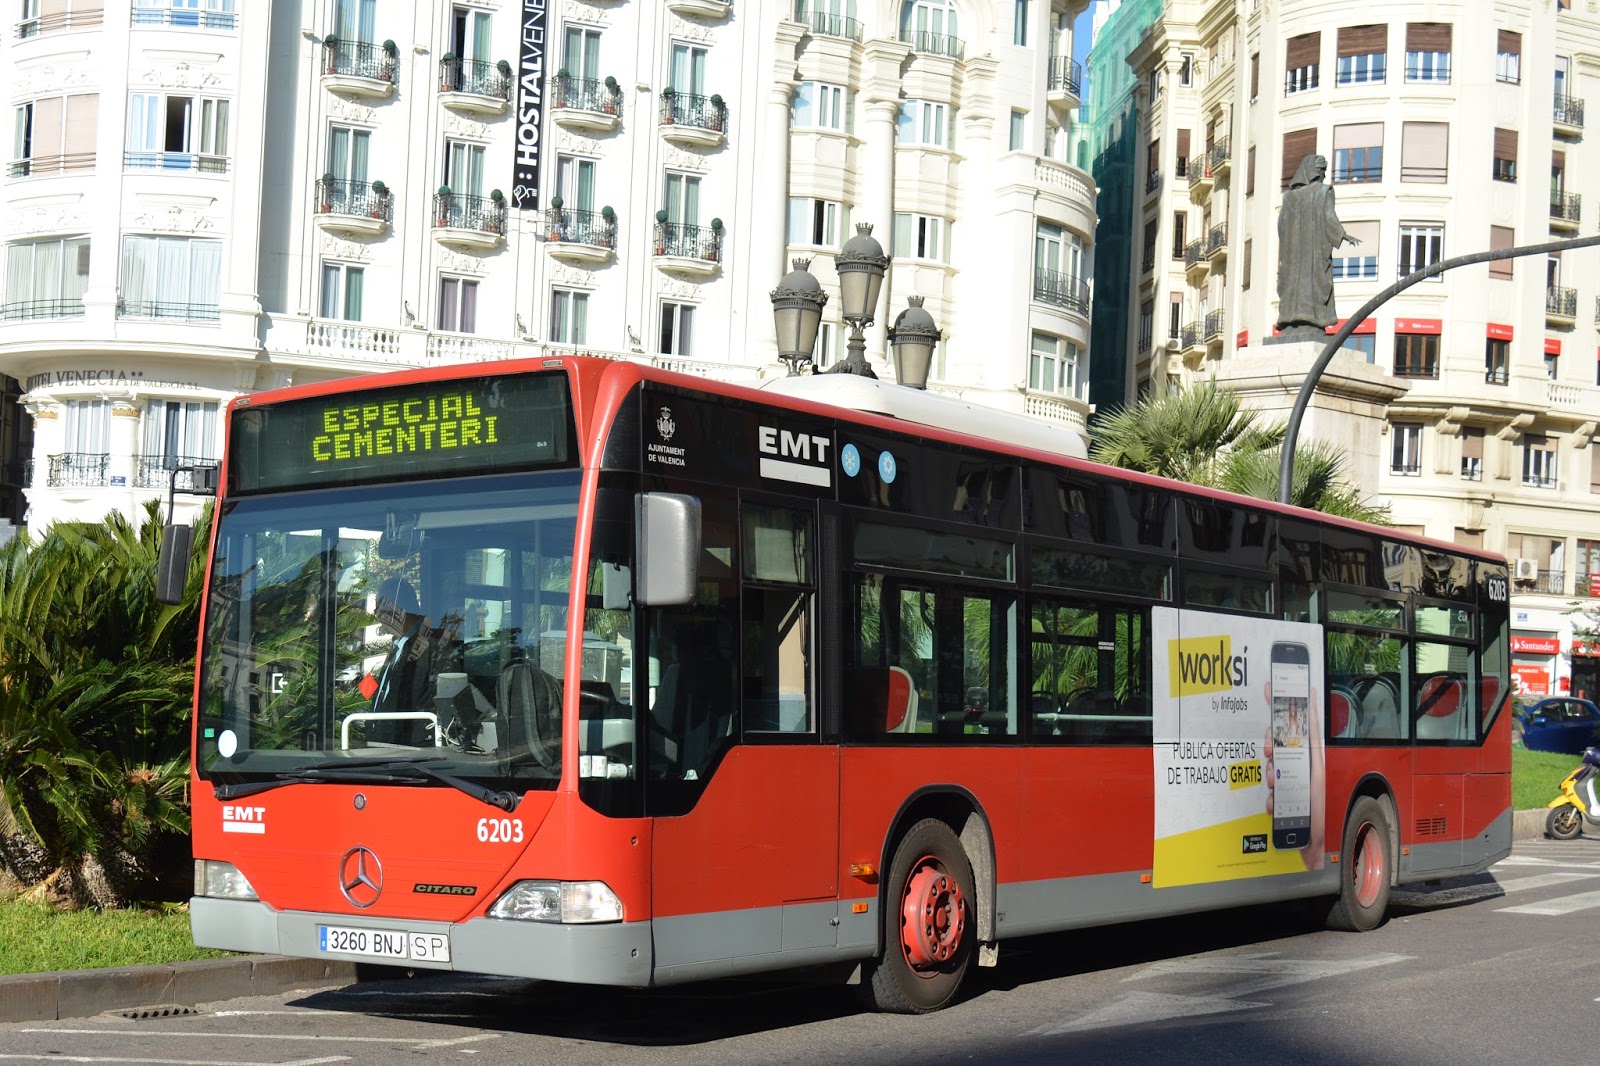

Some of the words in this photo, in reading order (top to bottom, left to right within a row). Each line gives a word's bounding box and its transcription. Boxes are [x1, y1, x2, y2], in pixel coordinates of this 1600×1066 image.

[56, 369, 129, 387] VENECIA
[324, 393, 482, 433] ESPECIAL
[313, 416, 499, 462] CEMENTERI
[758, 425, 831, 463] EMT
[648, 443, 686, 457] AJUNTAMENT
[648, 453, 657, 462] DE
[657, 455, 686, 467] VALENCIA
[1488, 579, 1506, 601] 6203
[1520, 640, 1555, 652] Santander
[1212, 699, 1219, 713] by
[1173, 741, 1213, 760] PUBLICA
[1216, 742, 1256, 759] OFERTAS
[1168, 767, 1181, 785] DE
[1184, 766, 1228, 784] TRABAJO
[1230, 765, 1262, 783] GRATIS
[223, 806, 266, 822] EMT
[476, 818, 524, 843] 6203
[415, 885, 475, 894] CITARO
[331, 930, 367, 951] 3260
[373, 934, 403, 955] BNJ
